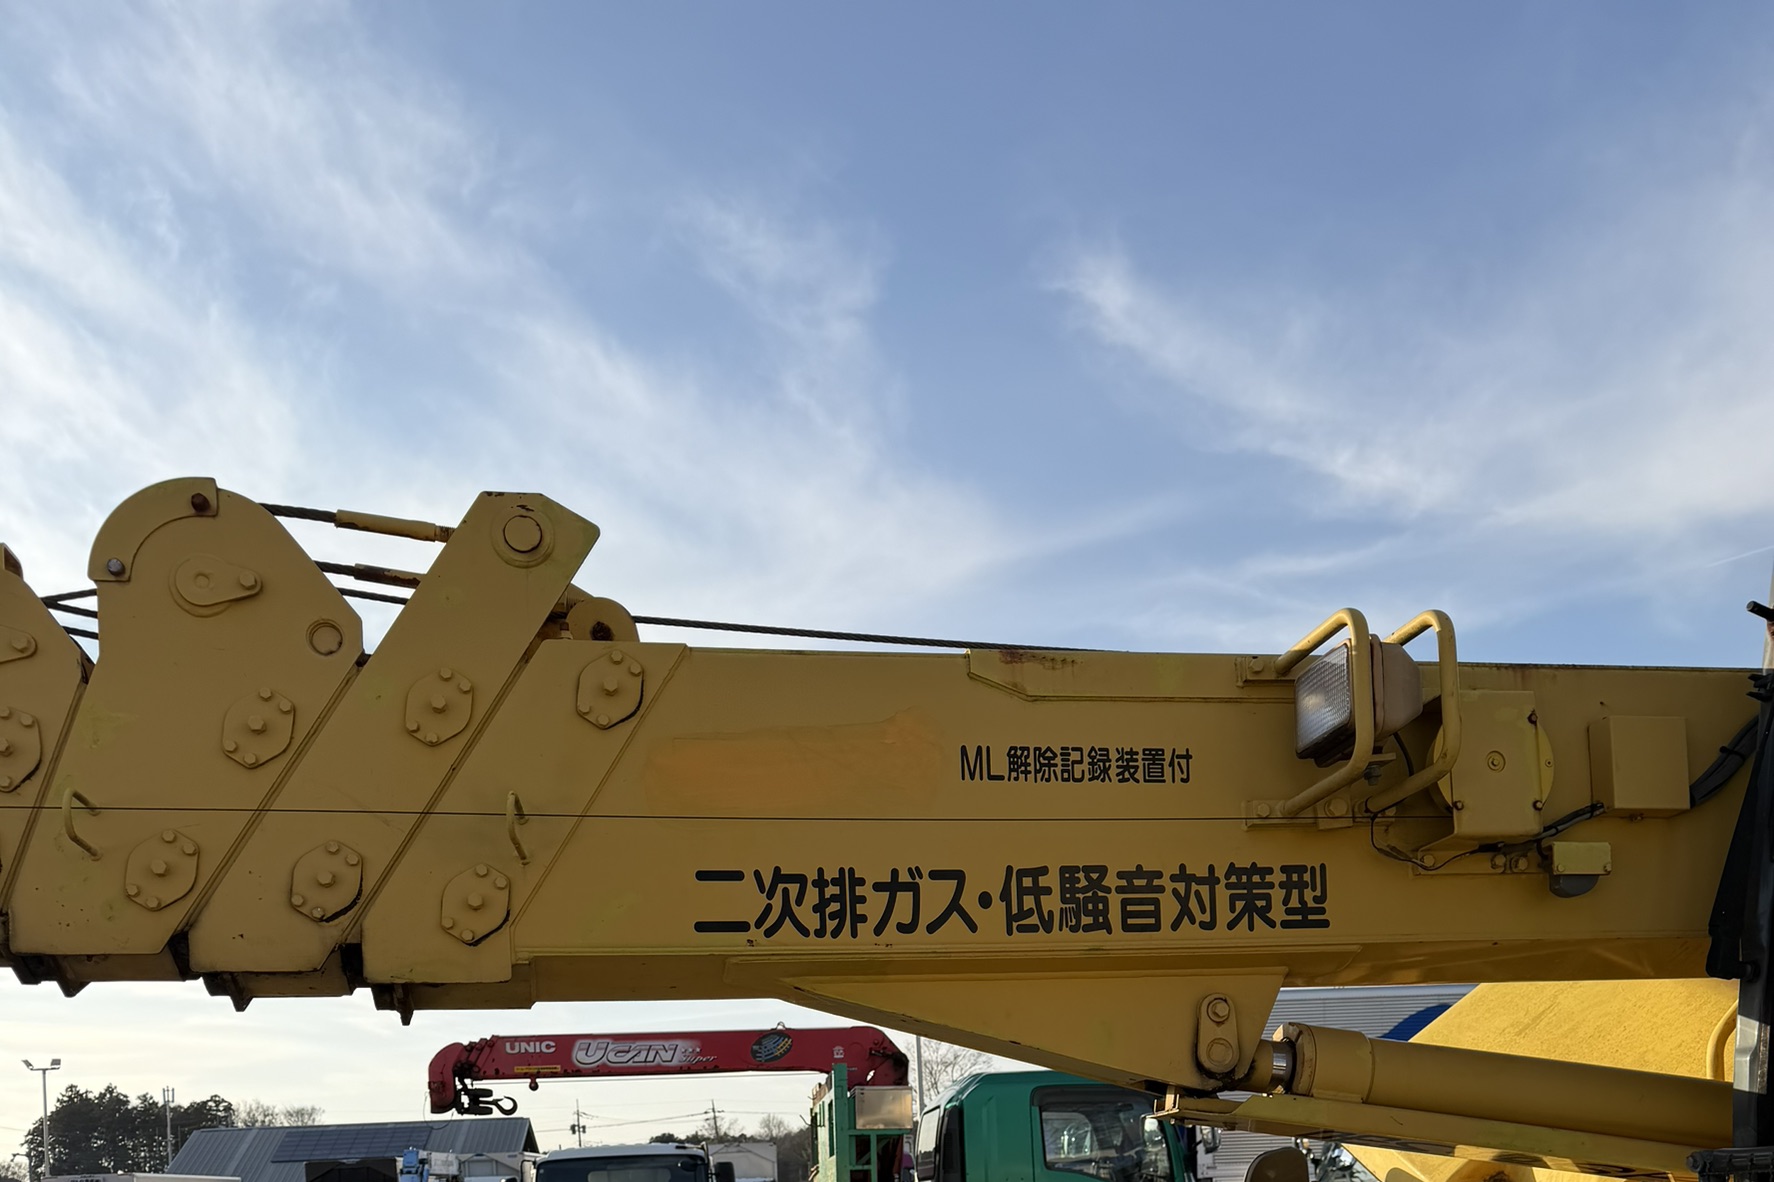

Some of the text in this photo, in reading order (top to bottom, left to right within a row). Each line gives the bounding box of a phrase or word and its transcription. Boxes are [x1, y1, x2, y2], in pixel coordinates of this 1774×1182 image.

[960, 744, 1193, 784] ML解除記録装置付
[694, 862, 1331, 939] 二次排ガス・低騒音対策型
[505, 1040, 556, 1054] UNIC
[574, 1041, 679, 1065] UCAN
